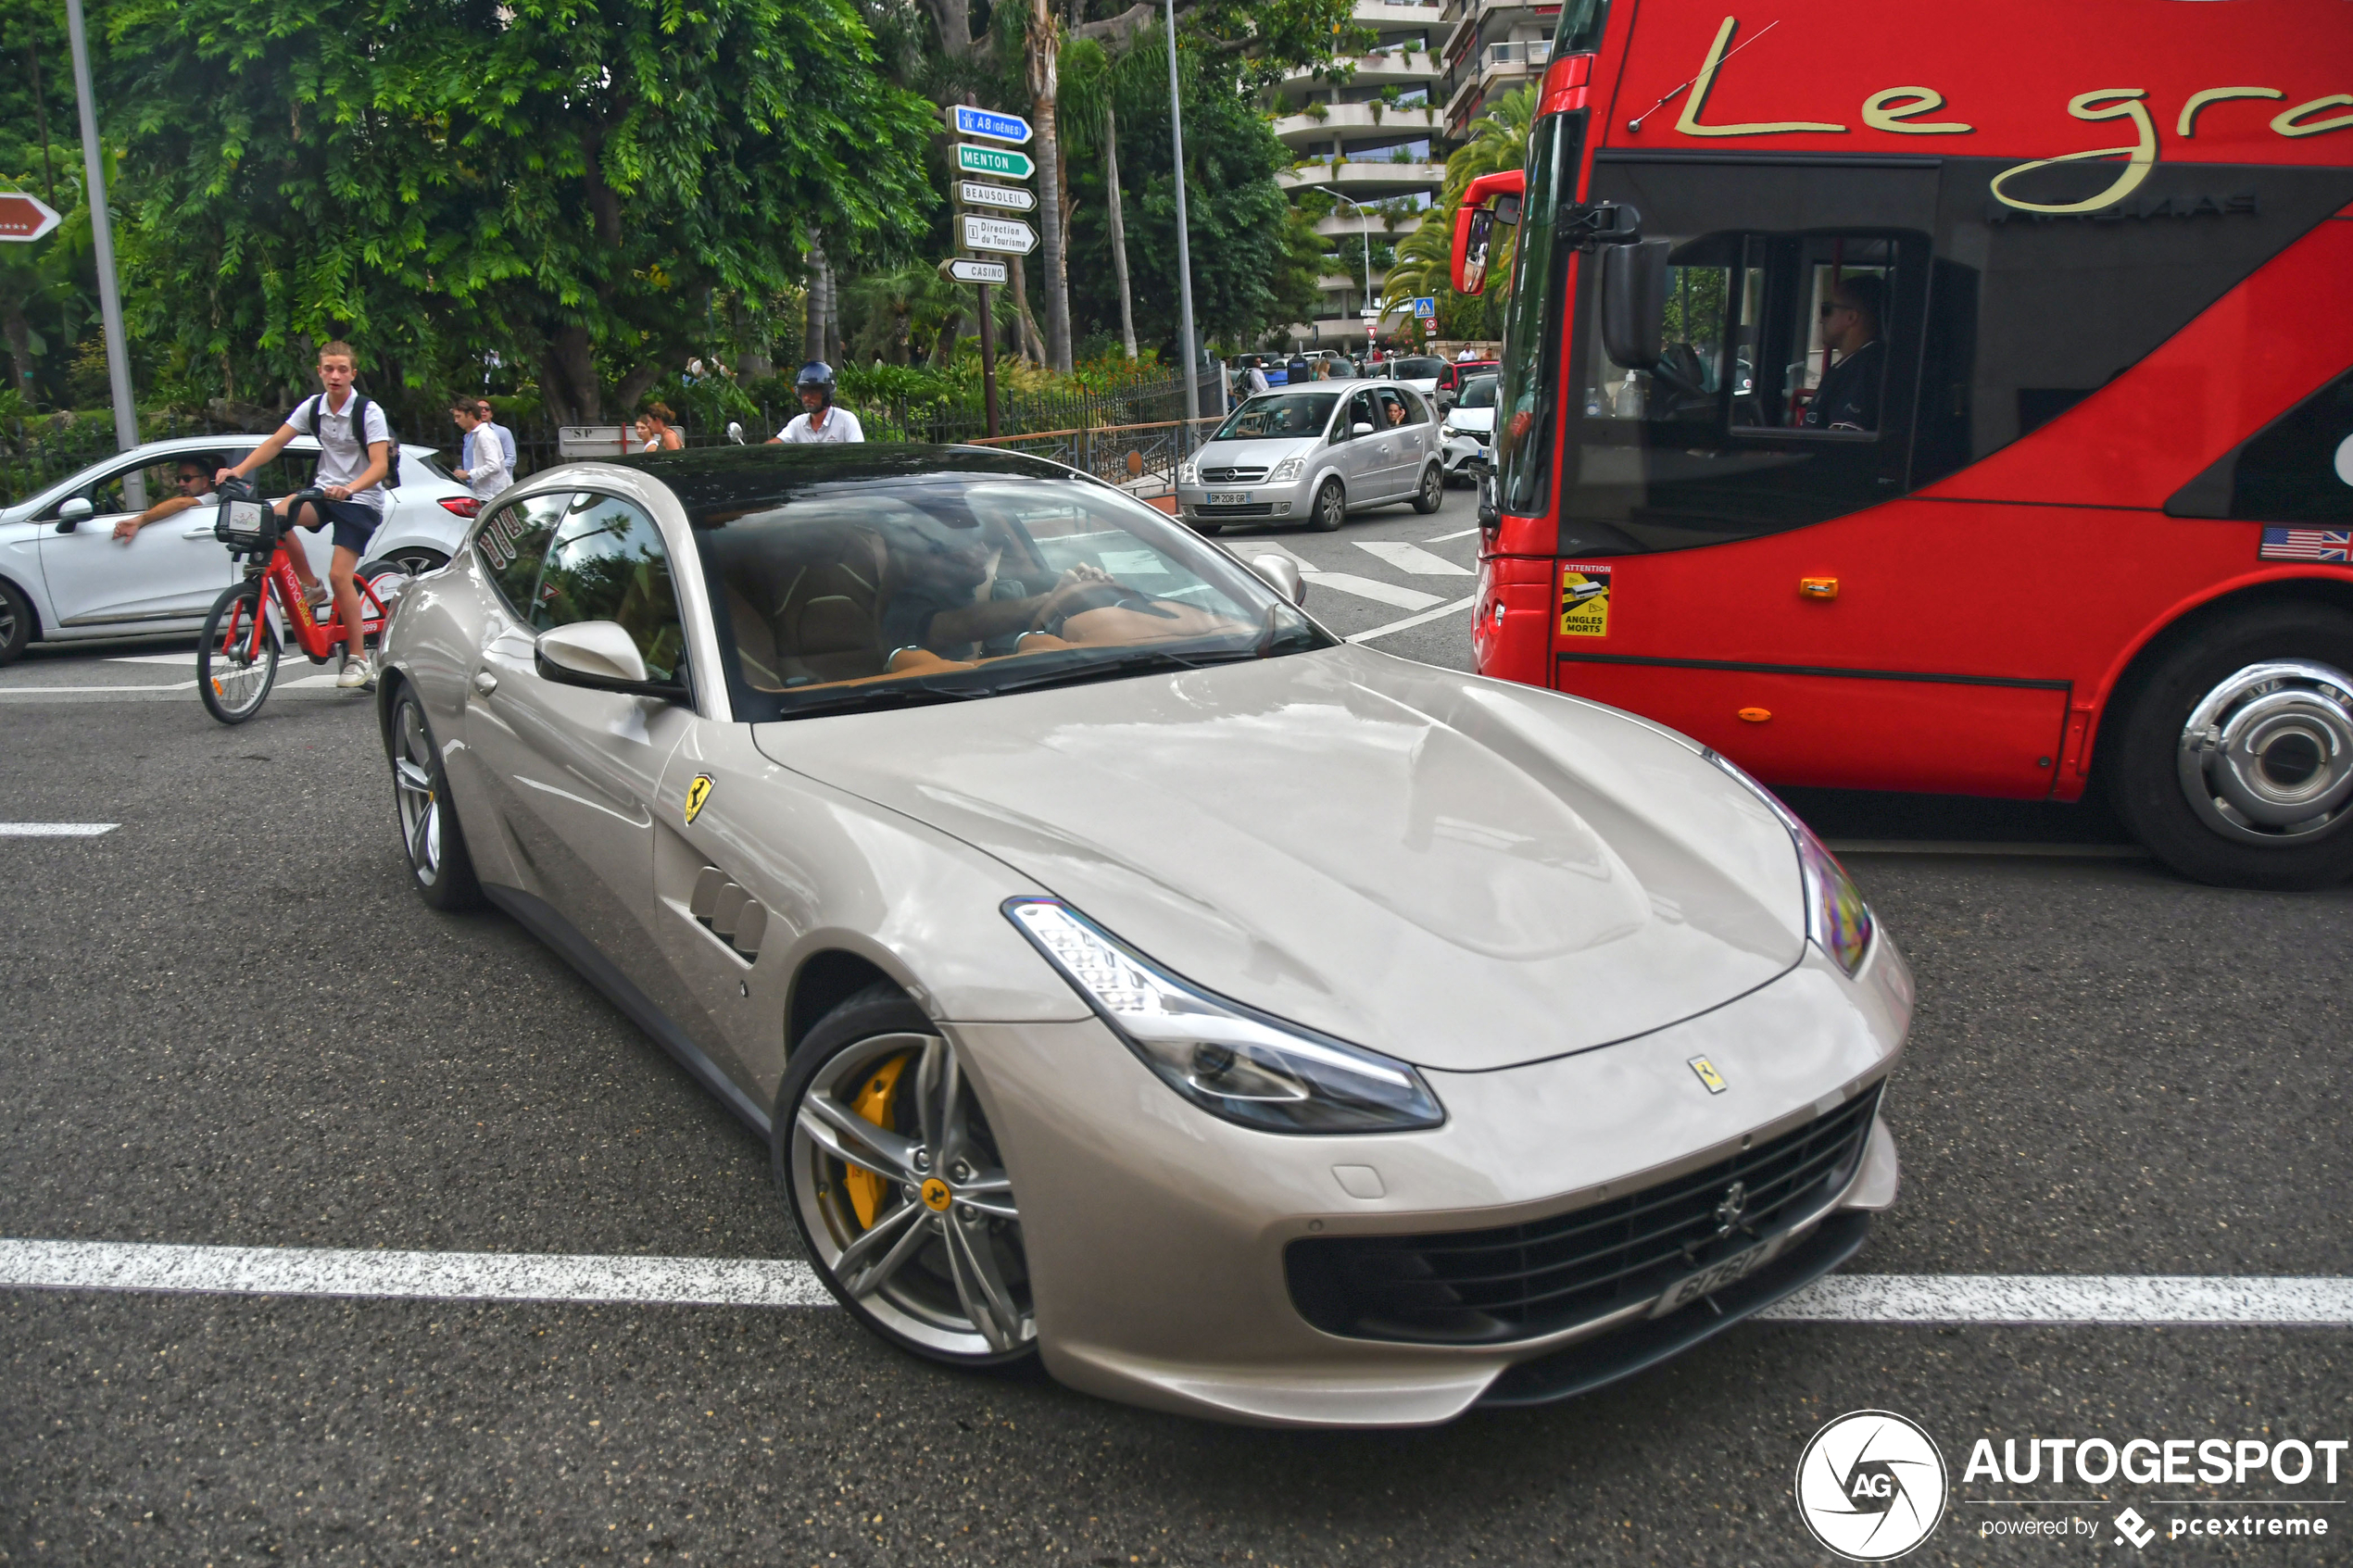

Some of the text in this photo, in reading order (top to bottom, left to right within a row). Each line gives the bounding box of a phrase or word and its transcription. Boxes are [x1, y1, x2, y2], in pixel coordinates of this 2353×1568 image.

[1675, 16, 1974, 136] Le
[976, 116, 991, 131] A8
[963, 150, 1009, 170] MENTON
[965, 187, 1023, 205] BEAUSOLEIL
[980, 221, 1020, 236] Direction
[981, 234, 1026, 248] du Tourisme
[971, 266, 1003, 278] CASINO
[1564, 564, 1612, 572] ATTENTION
[1566, 616, 1603, 624] ANGLES
[1567, 624, 1601, 633] MORTS
